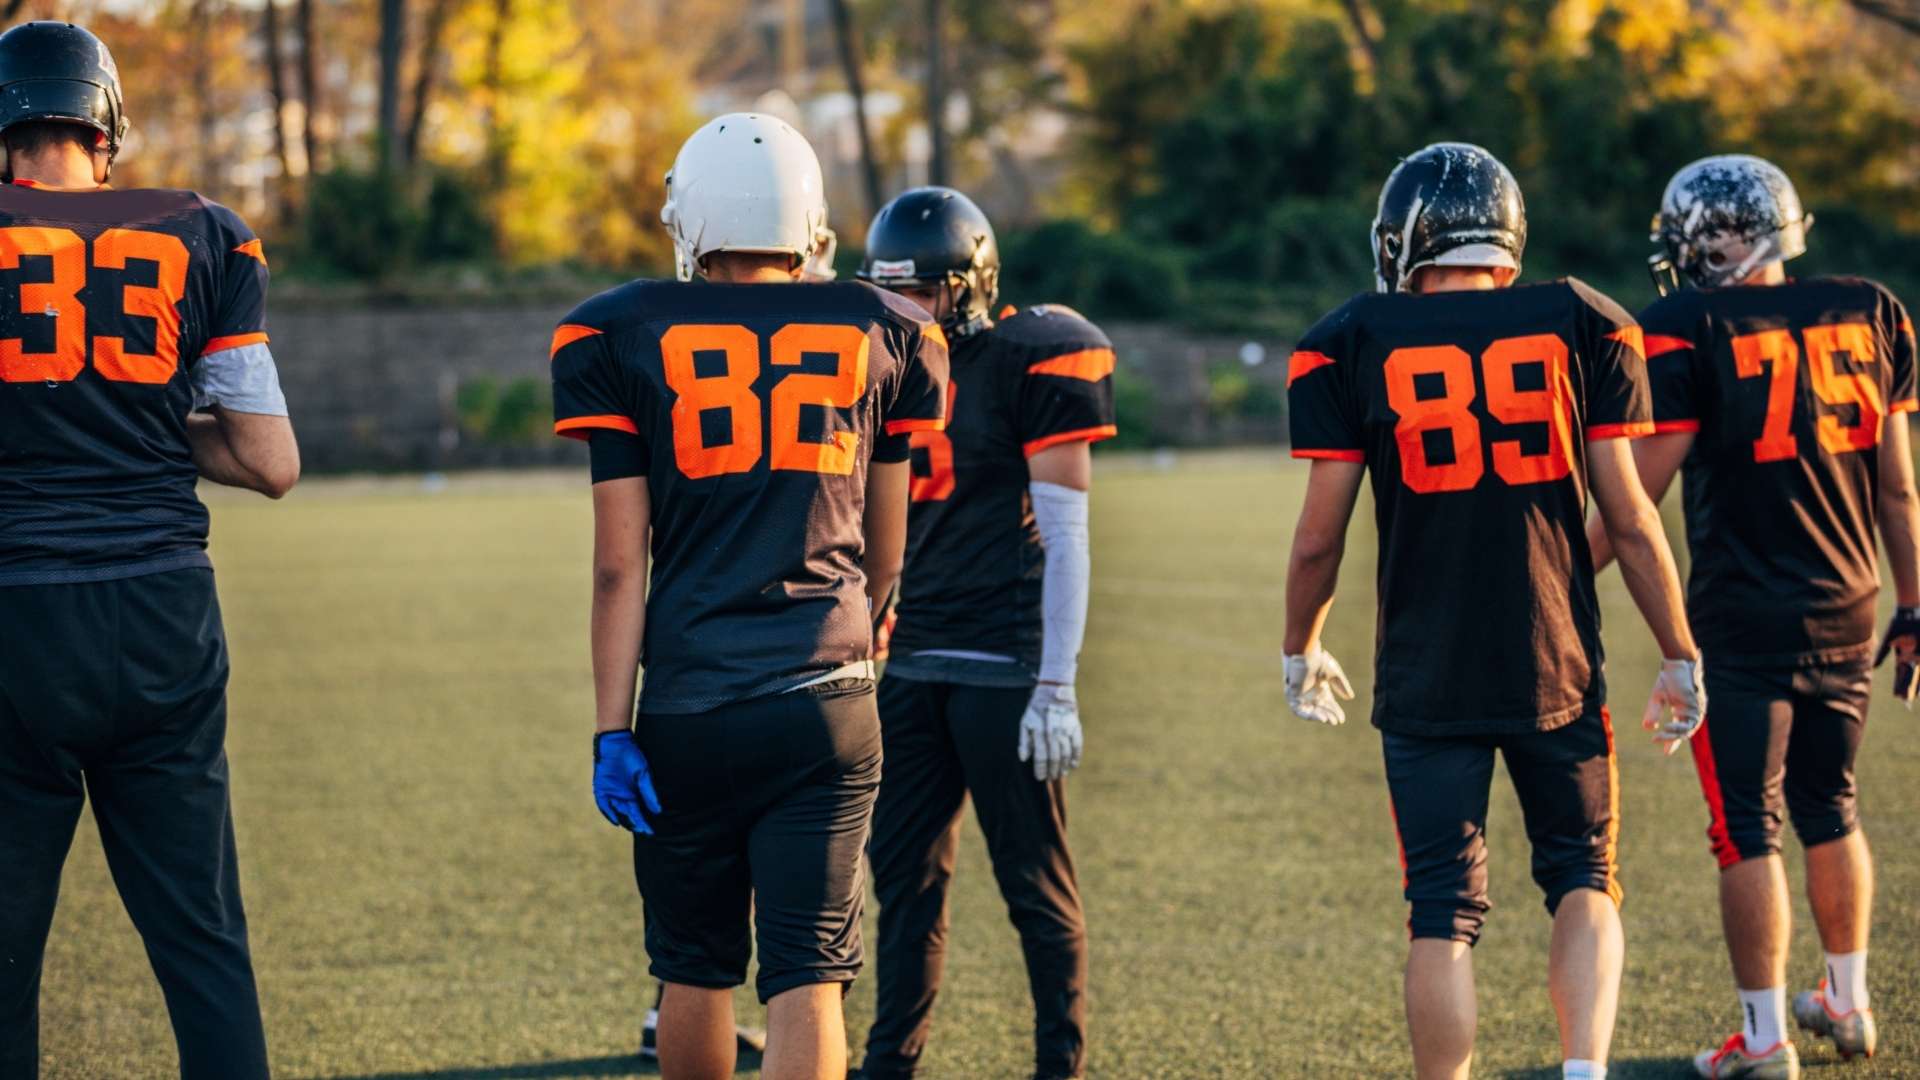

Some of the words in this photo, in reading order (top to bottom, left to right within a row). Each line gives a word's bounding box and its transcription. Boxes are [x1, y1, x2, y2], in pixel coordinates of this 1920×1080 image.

[0, 227, 190, 385] 33
[660, 323, 869, 480] 82
[1383, 333, 1574, 494] 89
[1731, 322, 1884, 463] 75
